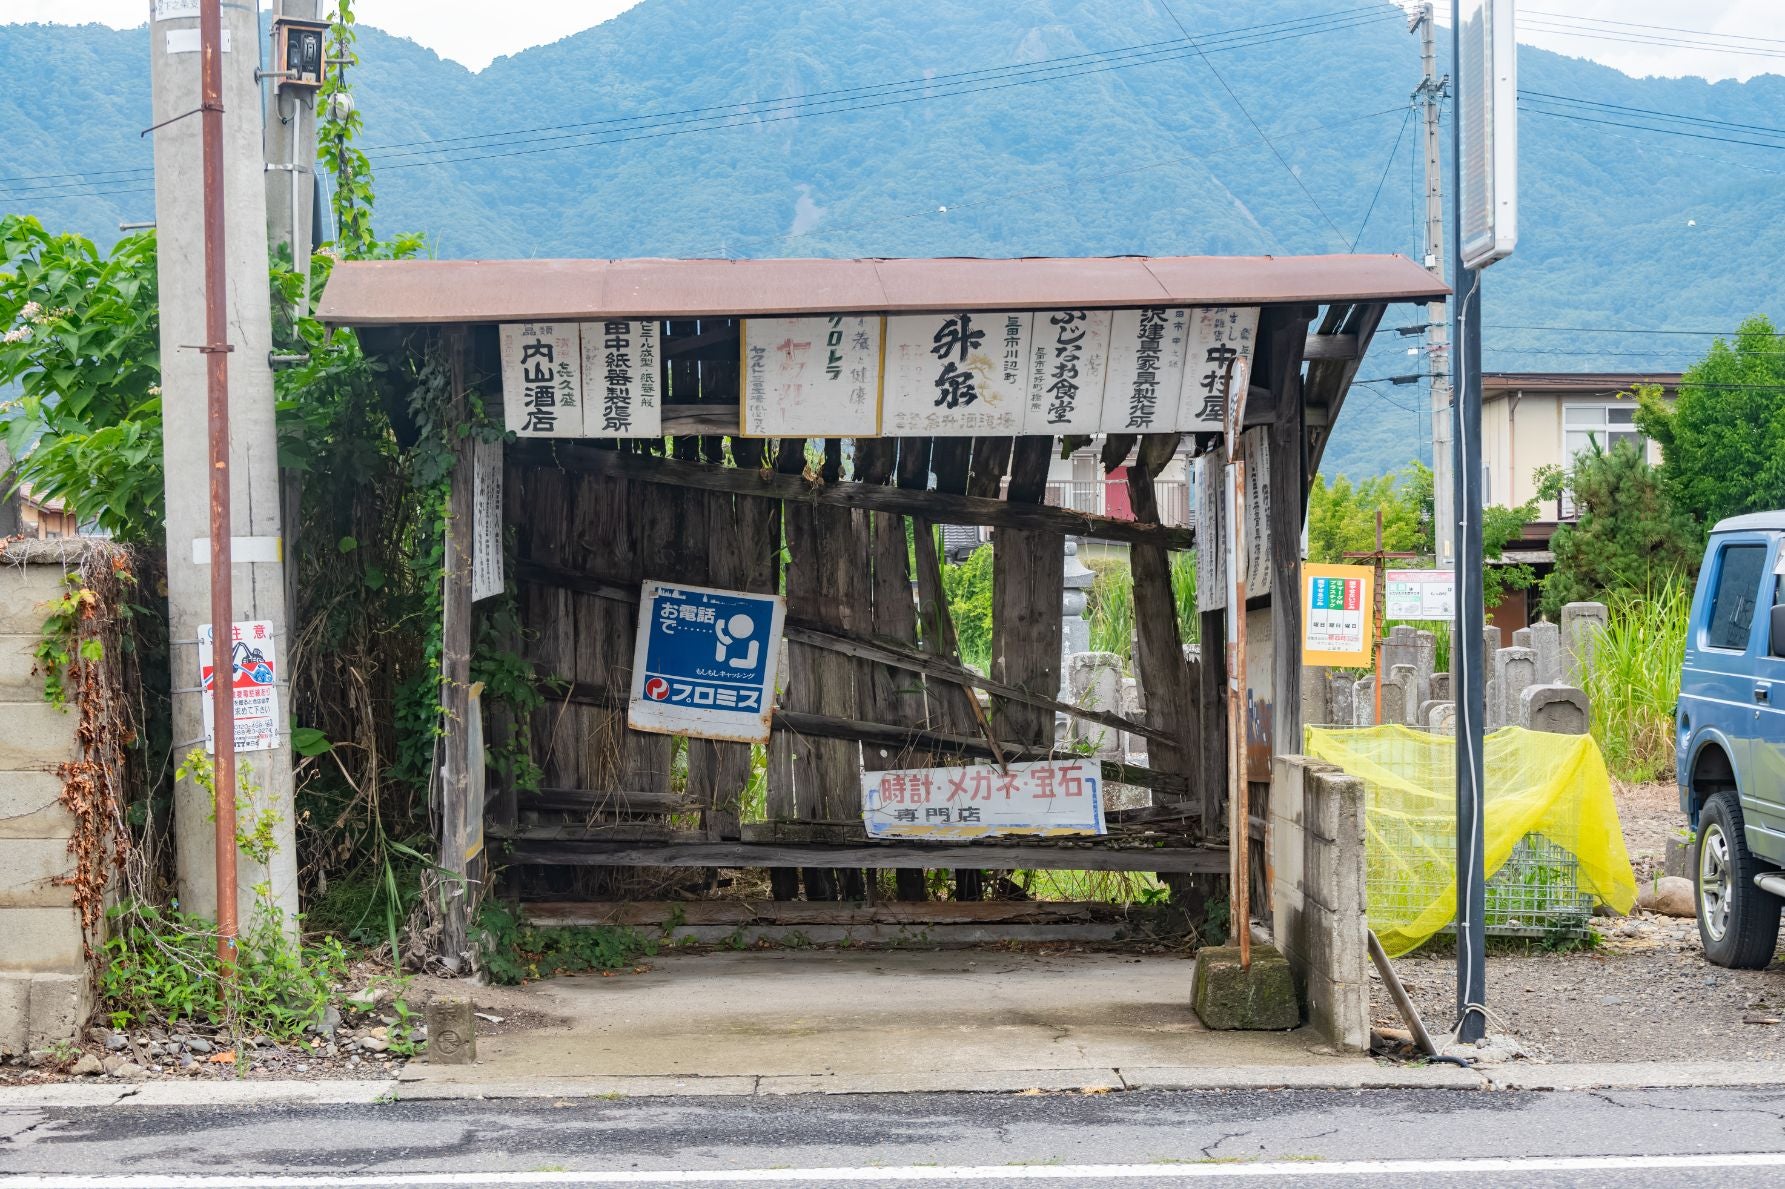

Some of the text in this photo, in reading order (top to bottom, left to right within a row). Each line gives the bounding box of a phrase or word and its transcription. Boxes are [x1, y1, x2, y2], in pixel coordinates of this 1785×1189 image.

[520, 338, 559, 432] 内山酒店
[661, 602, 716, 624] お電話
[696, 667, 755, 680] もしもしキャッシング
[671, 684, 758, 709] プロミス
[880, 766, 1084, 804] 時計・メガネ・宝石
[894, 806, 981, 823] 専門店
